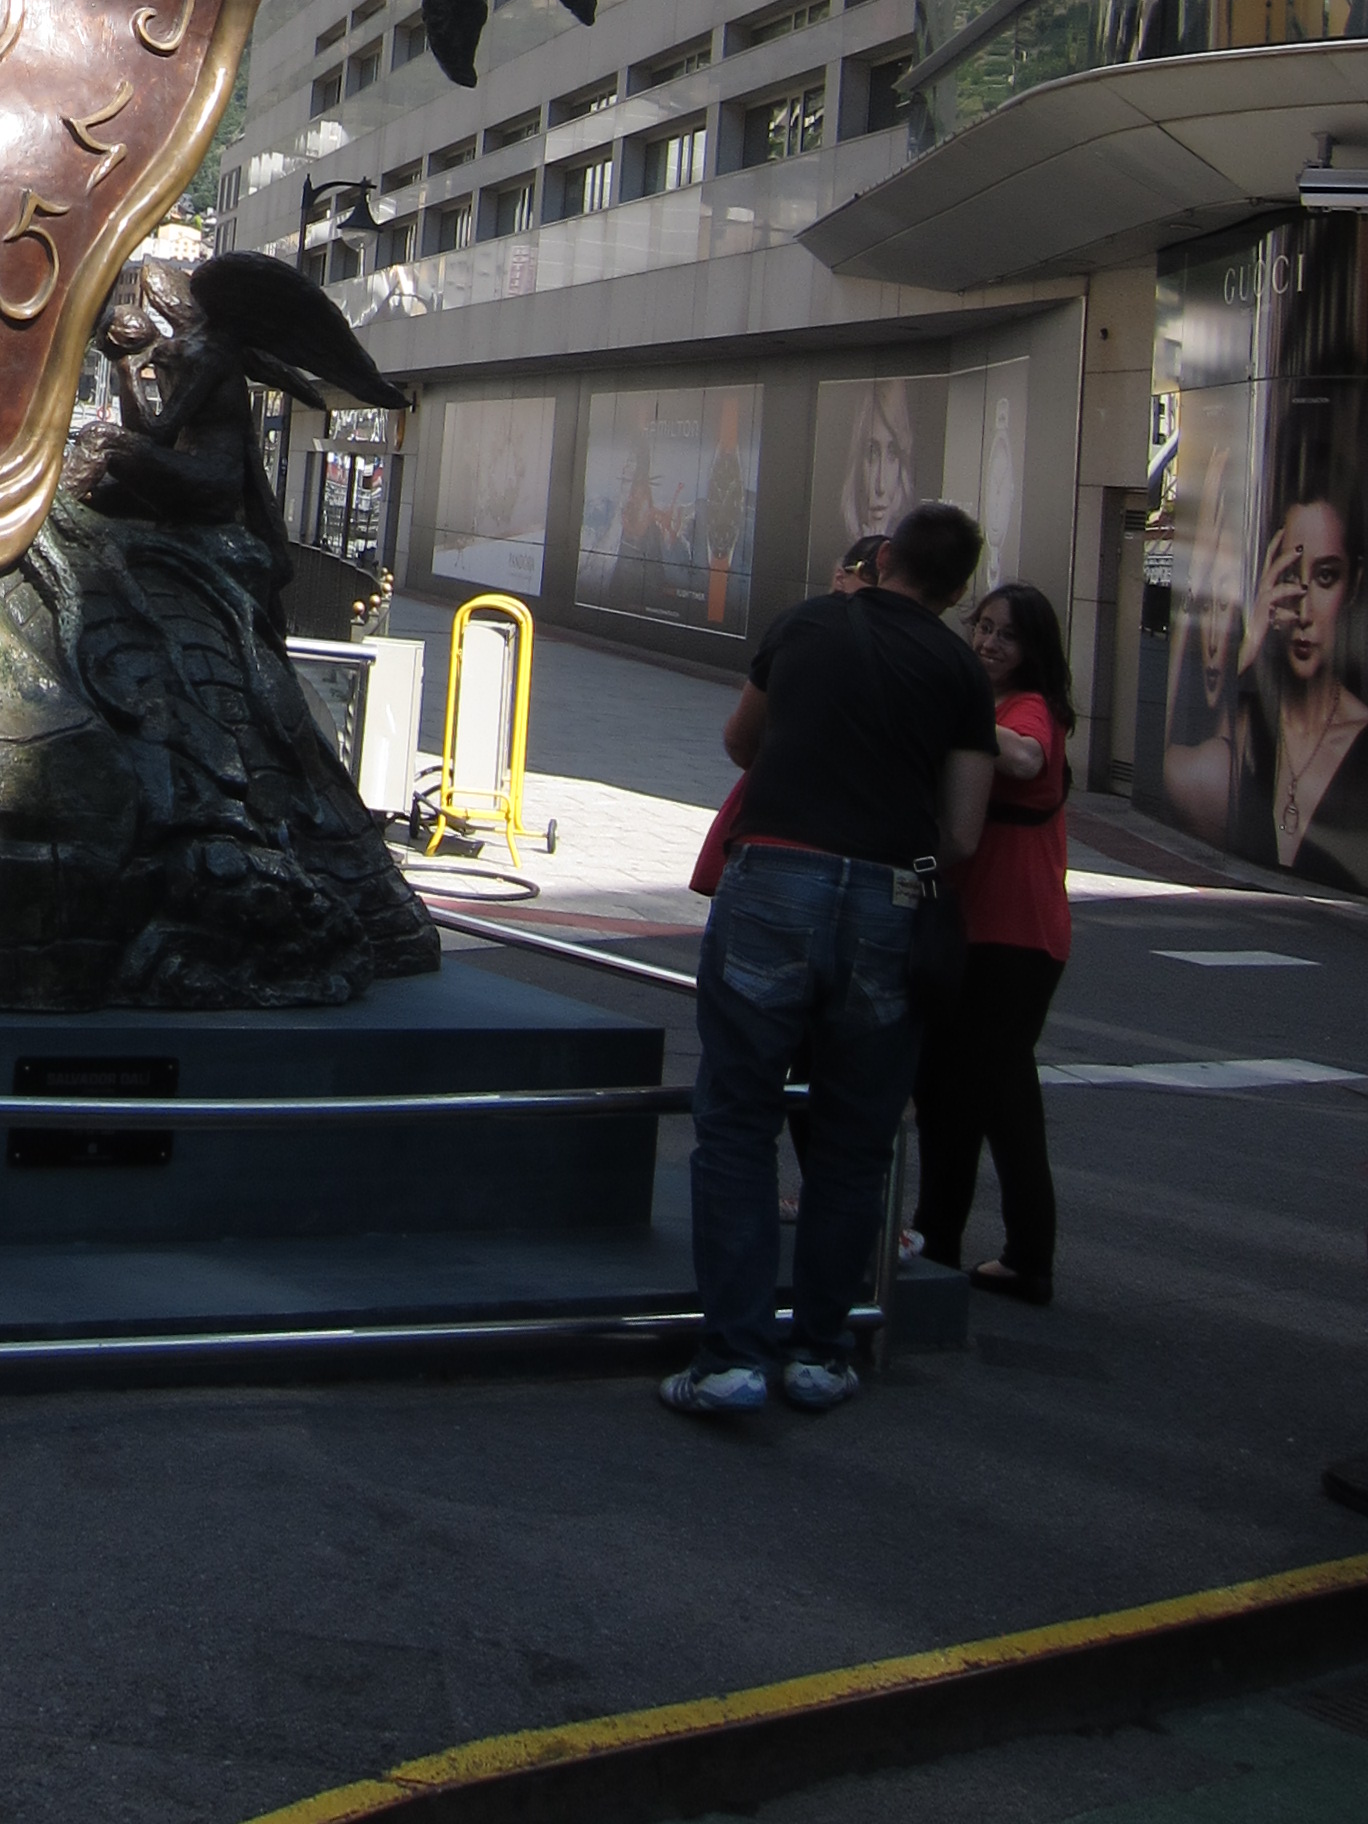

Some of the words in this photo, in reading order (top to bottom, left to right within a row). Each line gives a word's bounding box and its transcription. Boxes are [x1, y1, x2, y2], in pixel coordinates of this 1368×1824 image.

[1224, 253, 1305, 305] GUCCI
[642, 419, 700, 438] HAMILTON
[46, 1071, 116, 1086] SALVADOR
